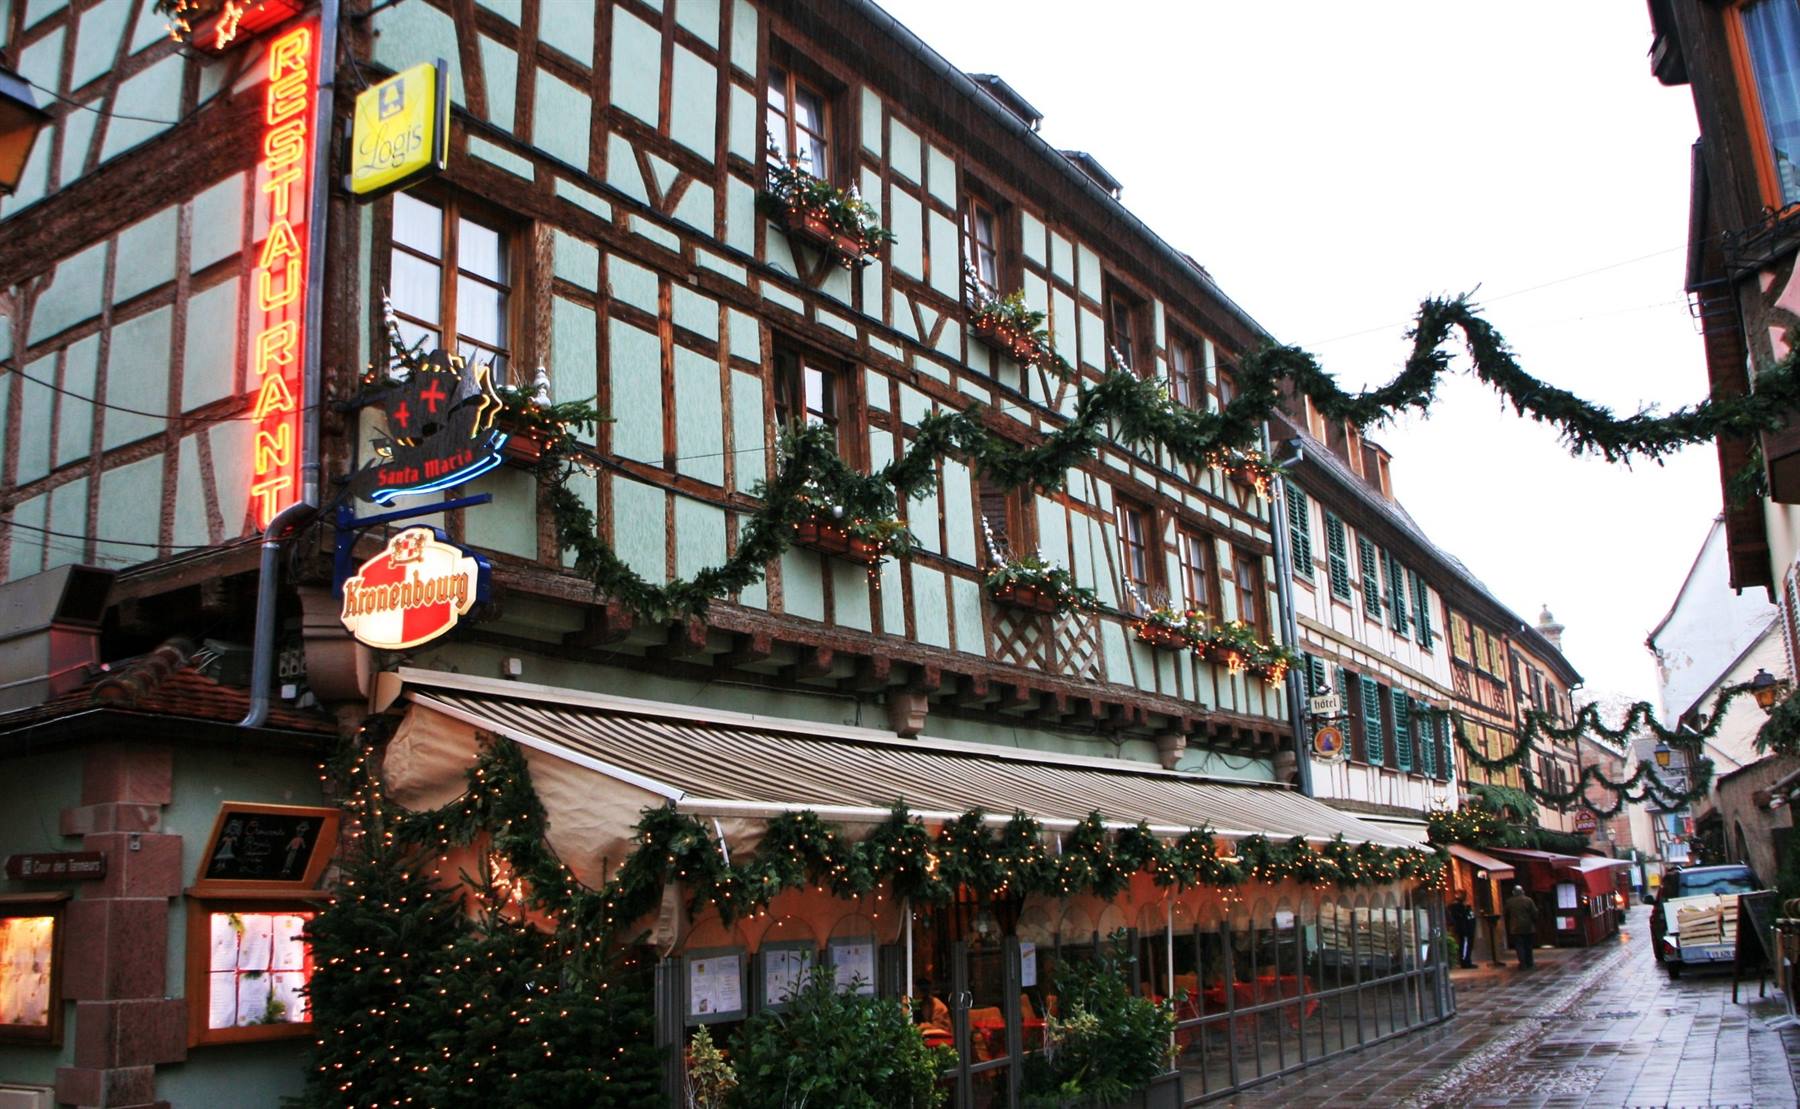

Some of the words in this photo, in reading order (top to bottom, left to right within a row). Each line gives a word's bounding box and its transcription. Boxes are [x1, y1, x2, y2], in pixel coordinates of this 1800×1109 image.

[356, 123, 423, 178] Logis
[252, 27, 310, 529] RESTAURANT
[377, 466, 420, 487] Santa
[424, 450, 473, 479] Maria
[344, 570, 469, 618] Kronenbourg
[1314, 698, 1337, 710] hôtel
